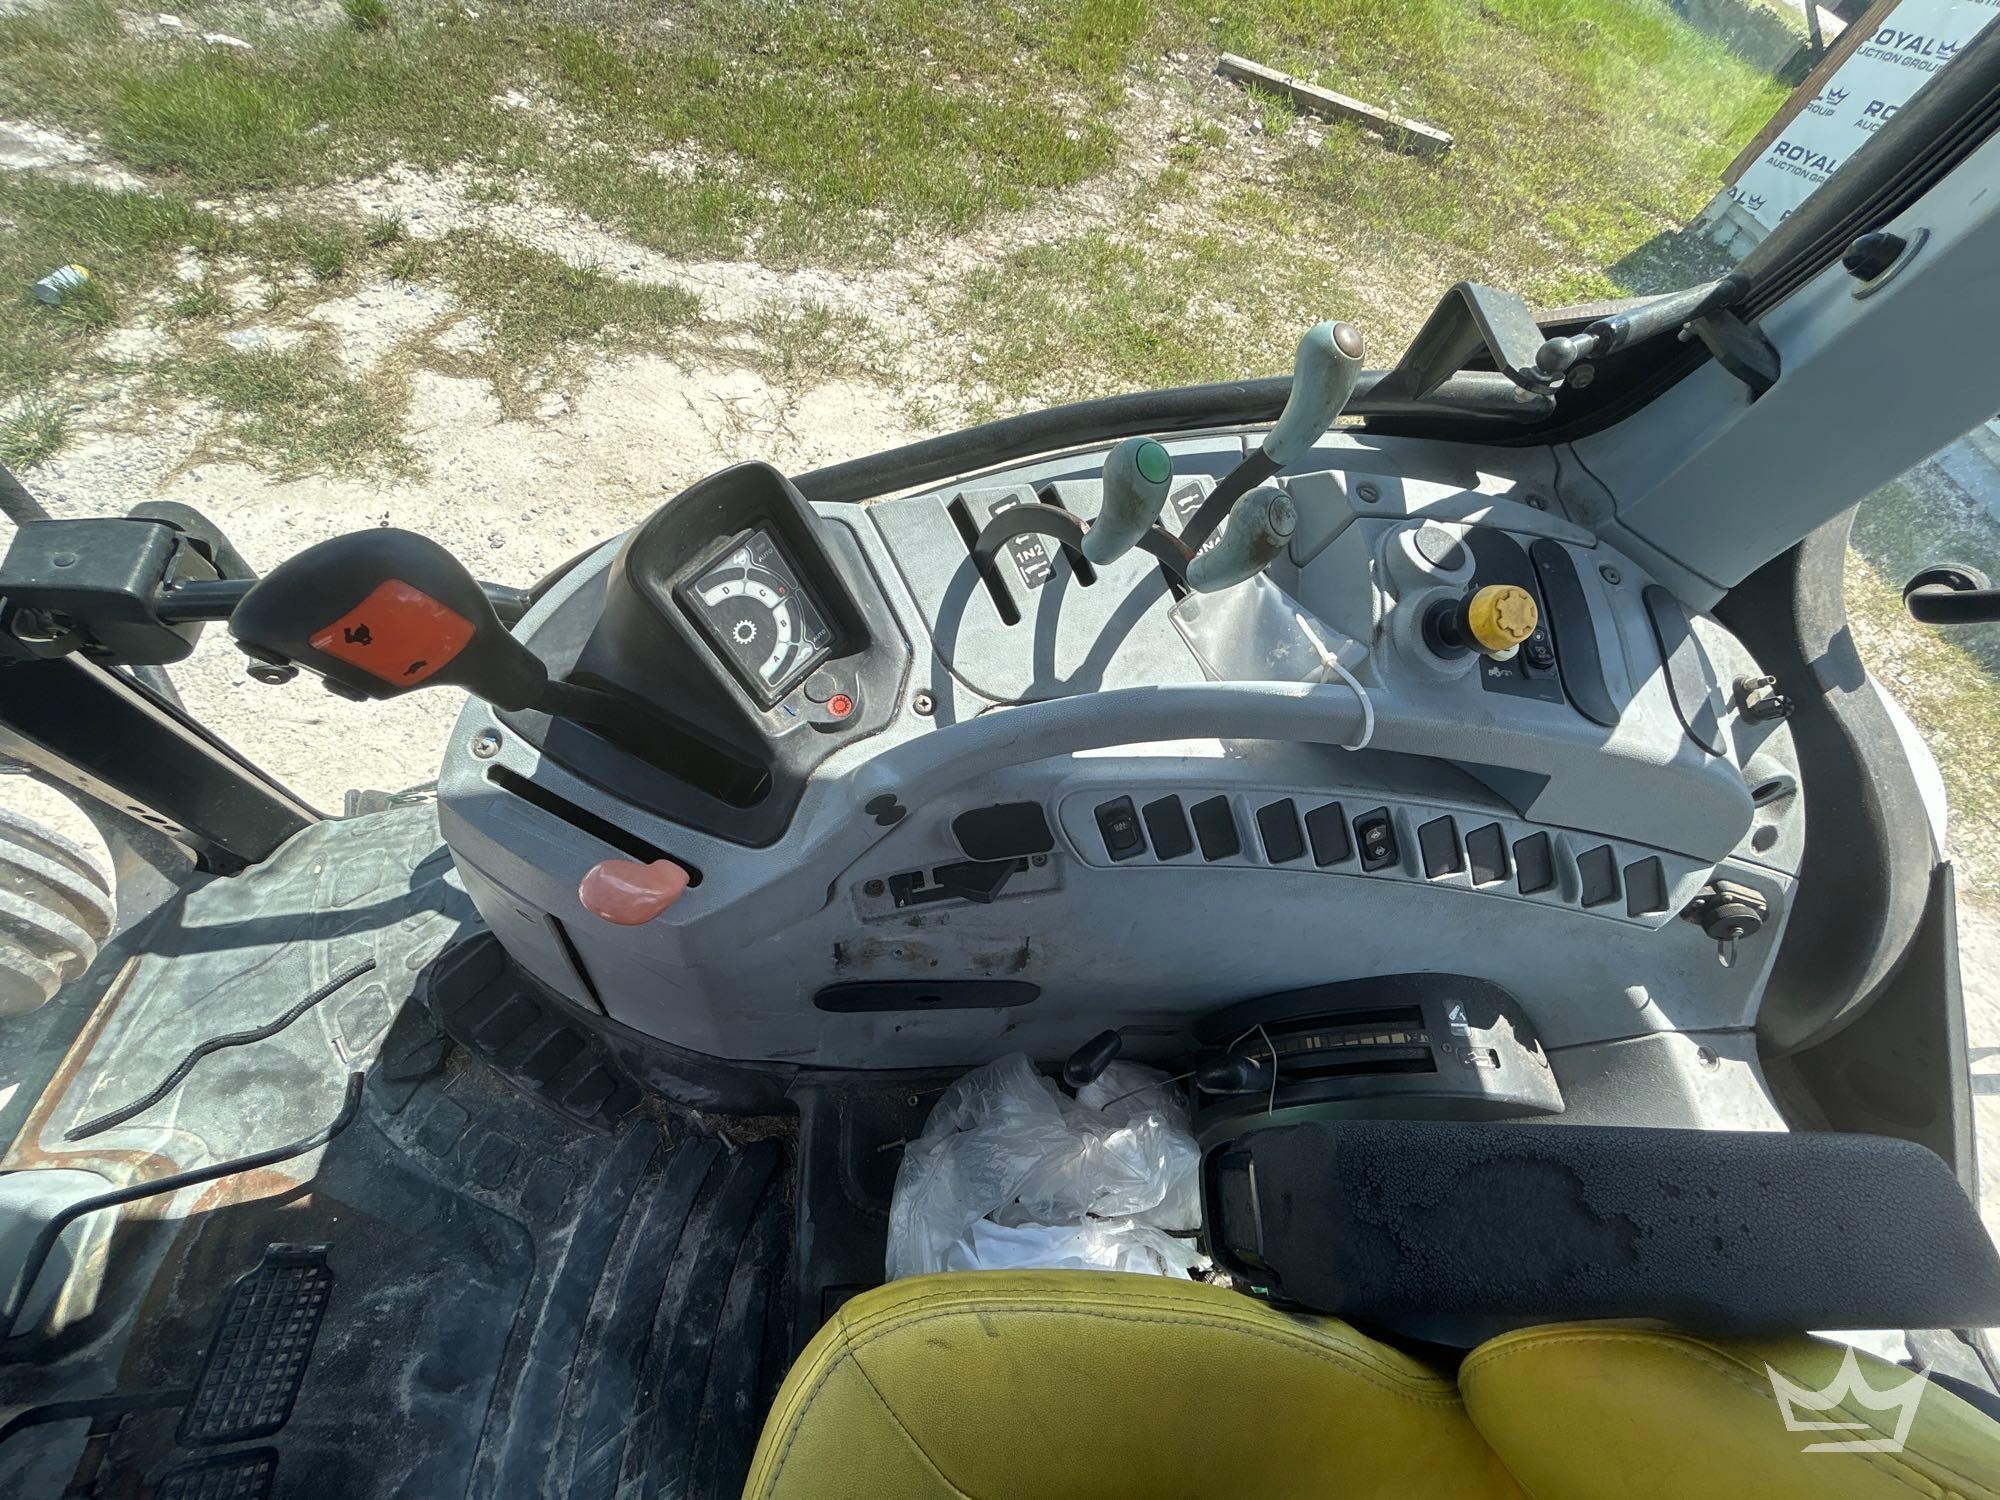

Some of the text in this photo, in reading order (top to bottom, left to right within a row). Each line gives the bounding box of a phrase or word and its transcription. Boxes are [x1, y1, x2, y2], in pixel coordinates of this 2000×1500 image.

[1869, 28, 1935, 56] OYAL
[1856, 46, 1943, 73] UCTION GROU
[1807, 102, 1835, 117] ROUP
[1773, 140, 1837, 174] ROYAL
[1765, 157, 1810, 179] AUCTION
[758, 548, 774, 562] AUTO
[1016, 544, 1044, 563] 1N2
[722, 586, 730, 595] D
[759, 589, 767, 597] C
[780, 620, 787, 628] B
[813, 628, 827, 642] AUTO
[773, 655, 780, 663] A
